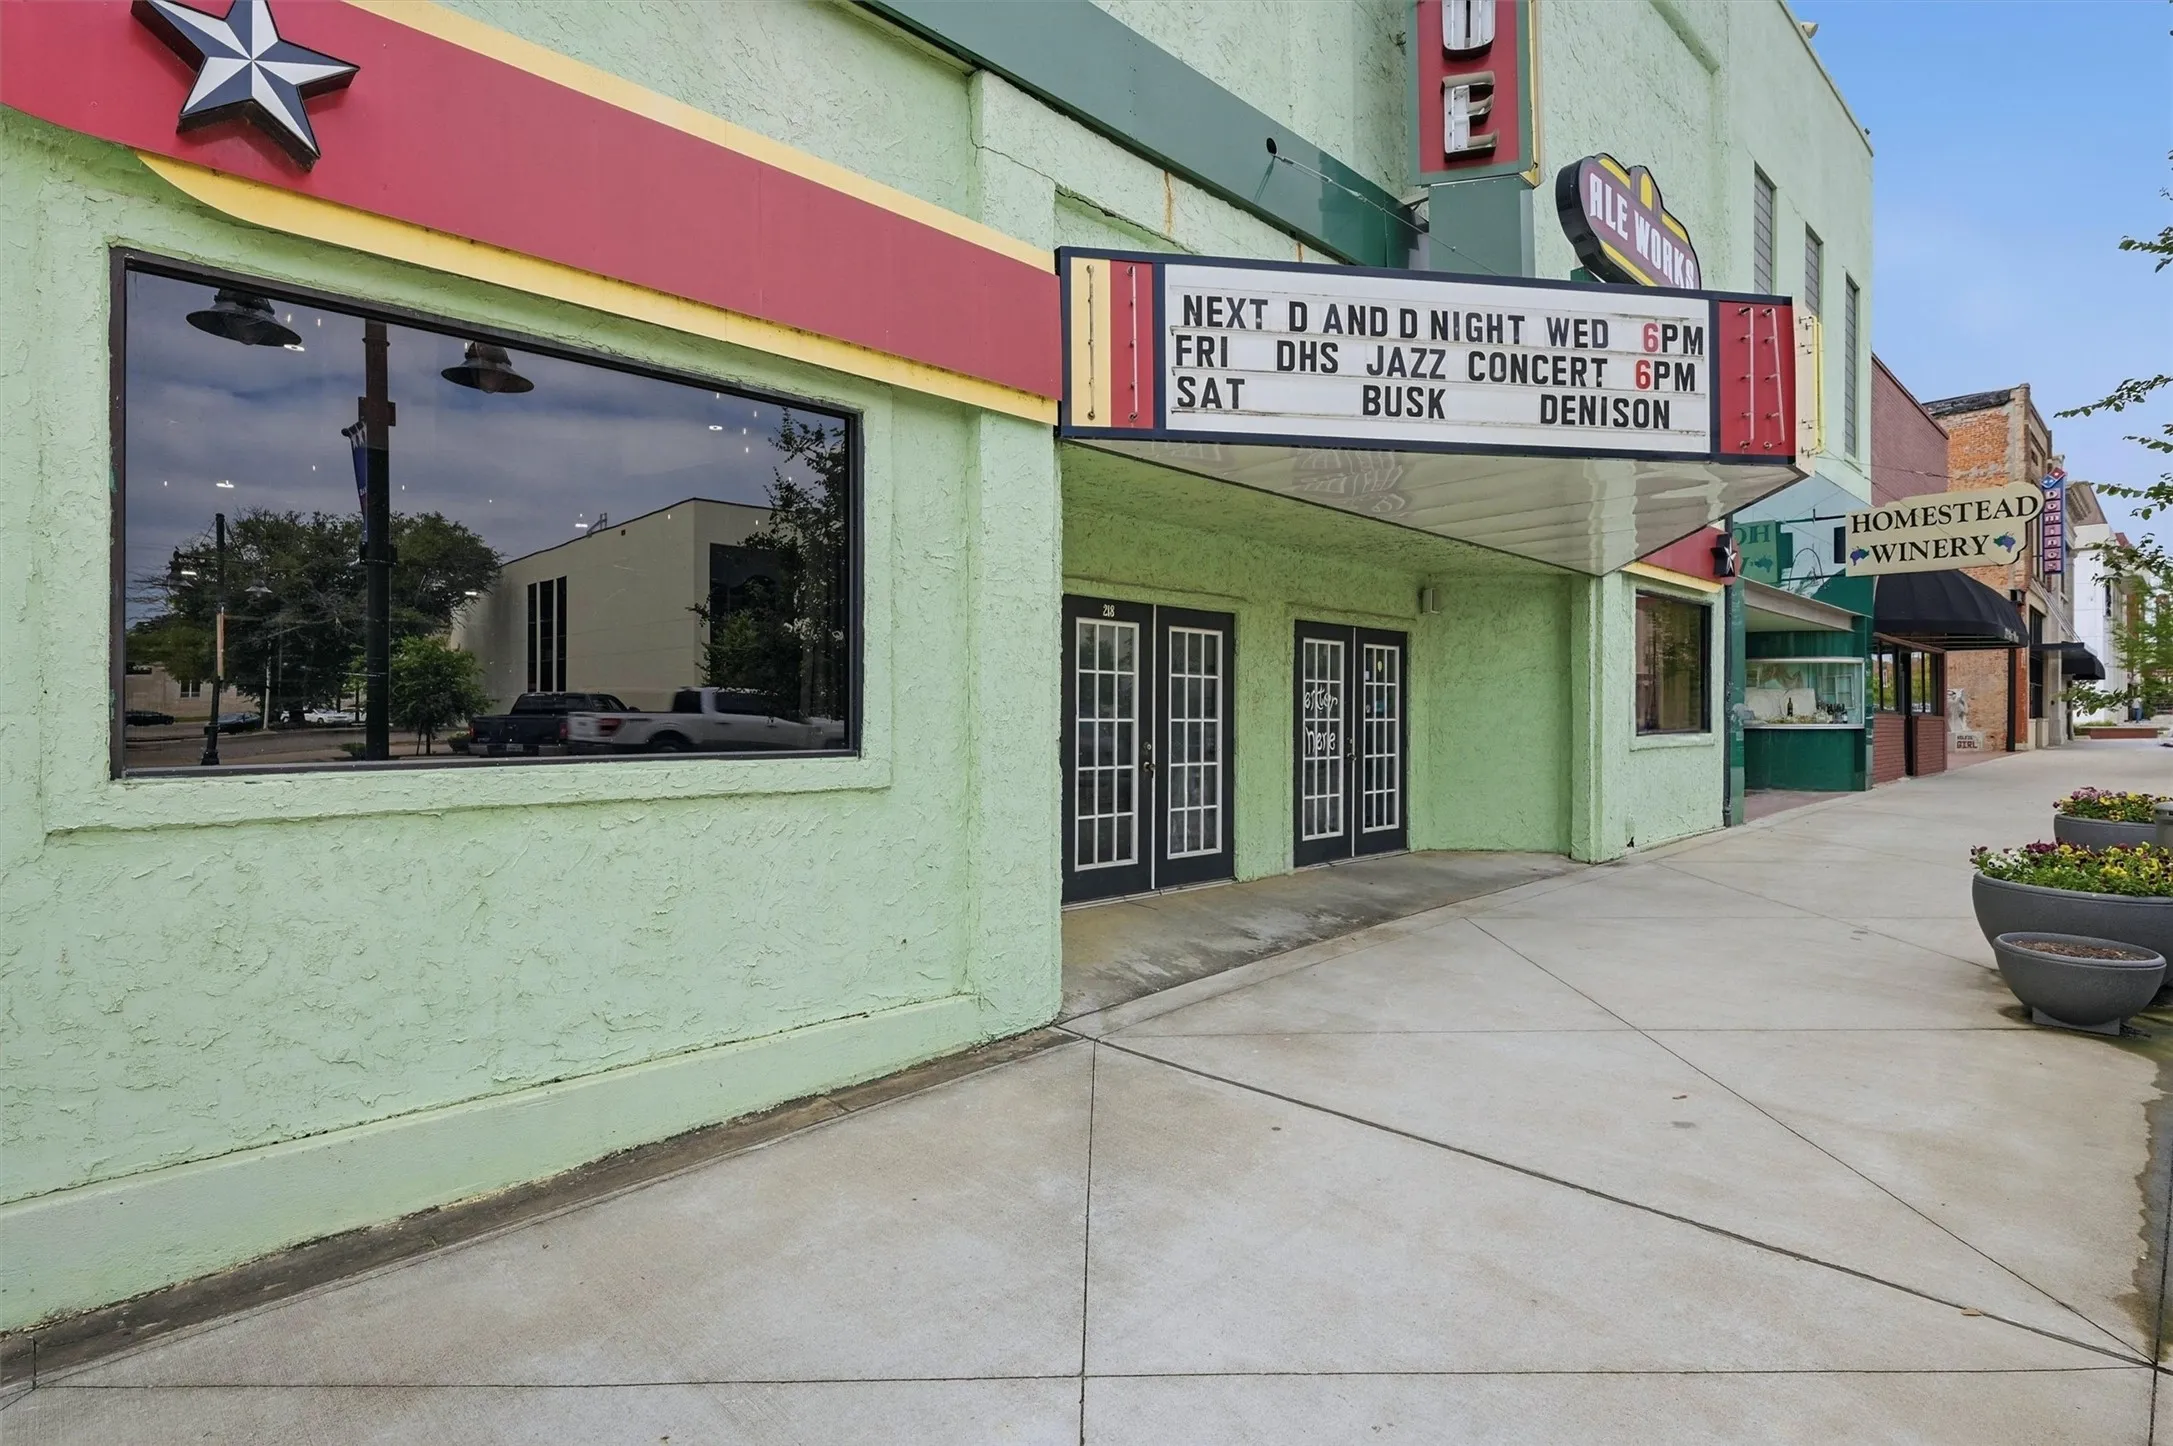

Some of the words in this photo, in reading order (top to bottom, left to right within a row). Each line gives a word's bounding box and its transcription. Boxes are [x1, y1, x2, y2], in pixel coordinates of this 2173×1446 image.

[1590, 172, 1628, 241] ALE
[1634, 209, 1695, 290] WORKS
[1183, 294, 1268, 330] NEXT
[1289, 300, 1308, 333] D
[1322, 303, 1388, 338] AND
[1400, 308, 1418, 340] D
[1430, 309, 1526, 346] NIGHT
[1546, 316, 1609, 350] WED
[1642, 322, 1704, 357] 6PM
[1175, 335, 1228, 368] FRI
[1276, 339, 1339, 374] DHS
[1366, 345, 1447, 380] JAZZ
[1468, 350, 1608, 388] CONCERT
[1635, 359, 1696, 392] 6PM
[1176, 376, 1245, 410] SAT
[1362, 384, 1446, 420] BUSK
[1540, 393, 1670, 430] DENISON
[1851, 495, 2039, 534] HOMESTEAD
[1870, 535, 1991, 564] WINERY
[1102, 603, 1115, 618] 218
[1305, 726, 1336, 755] here
